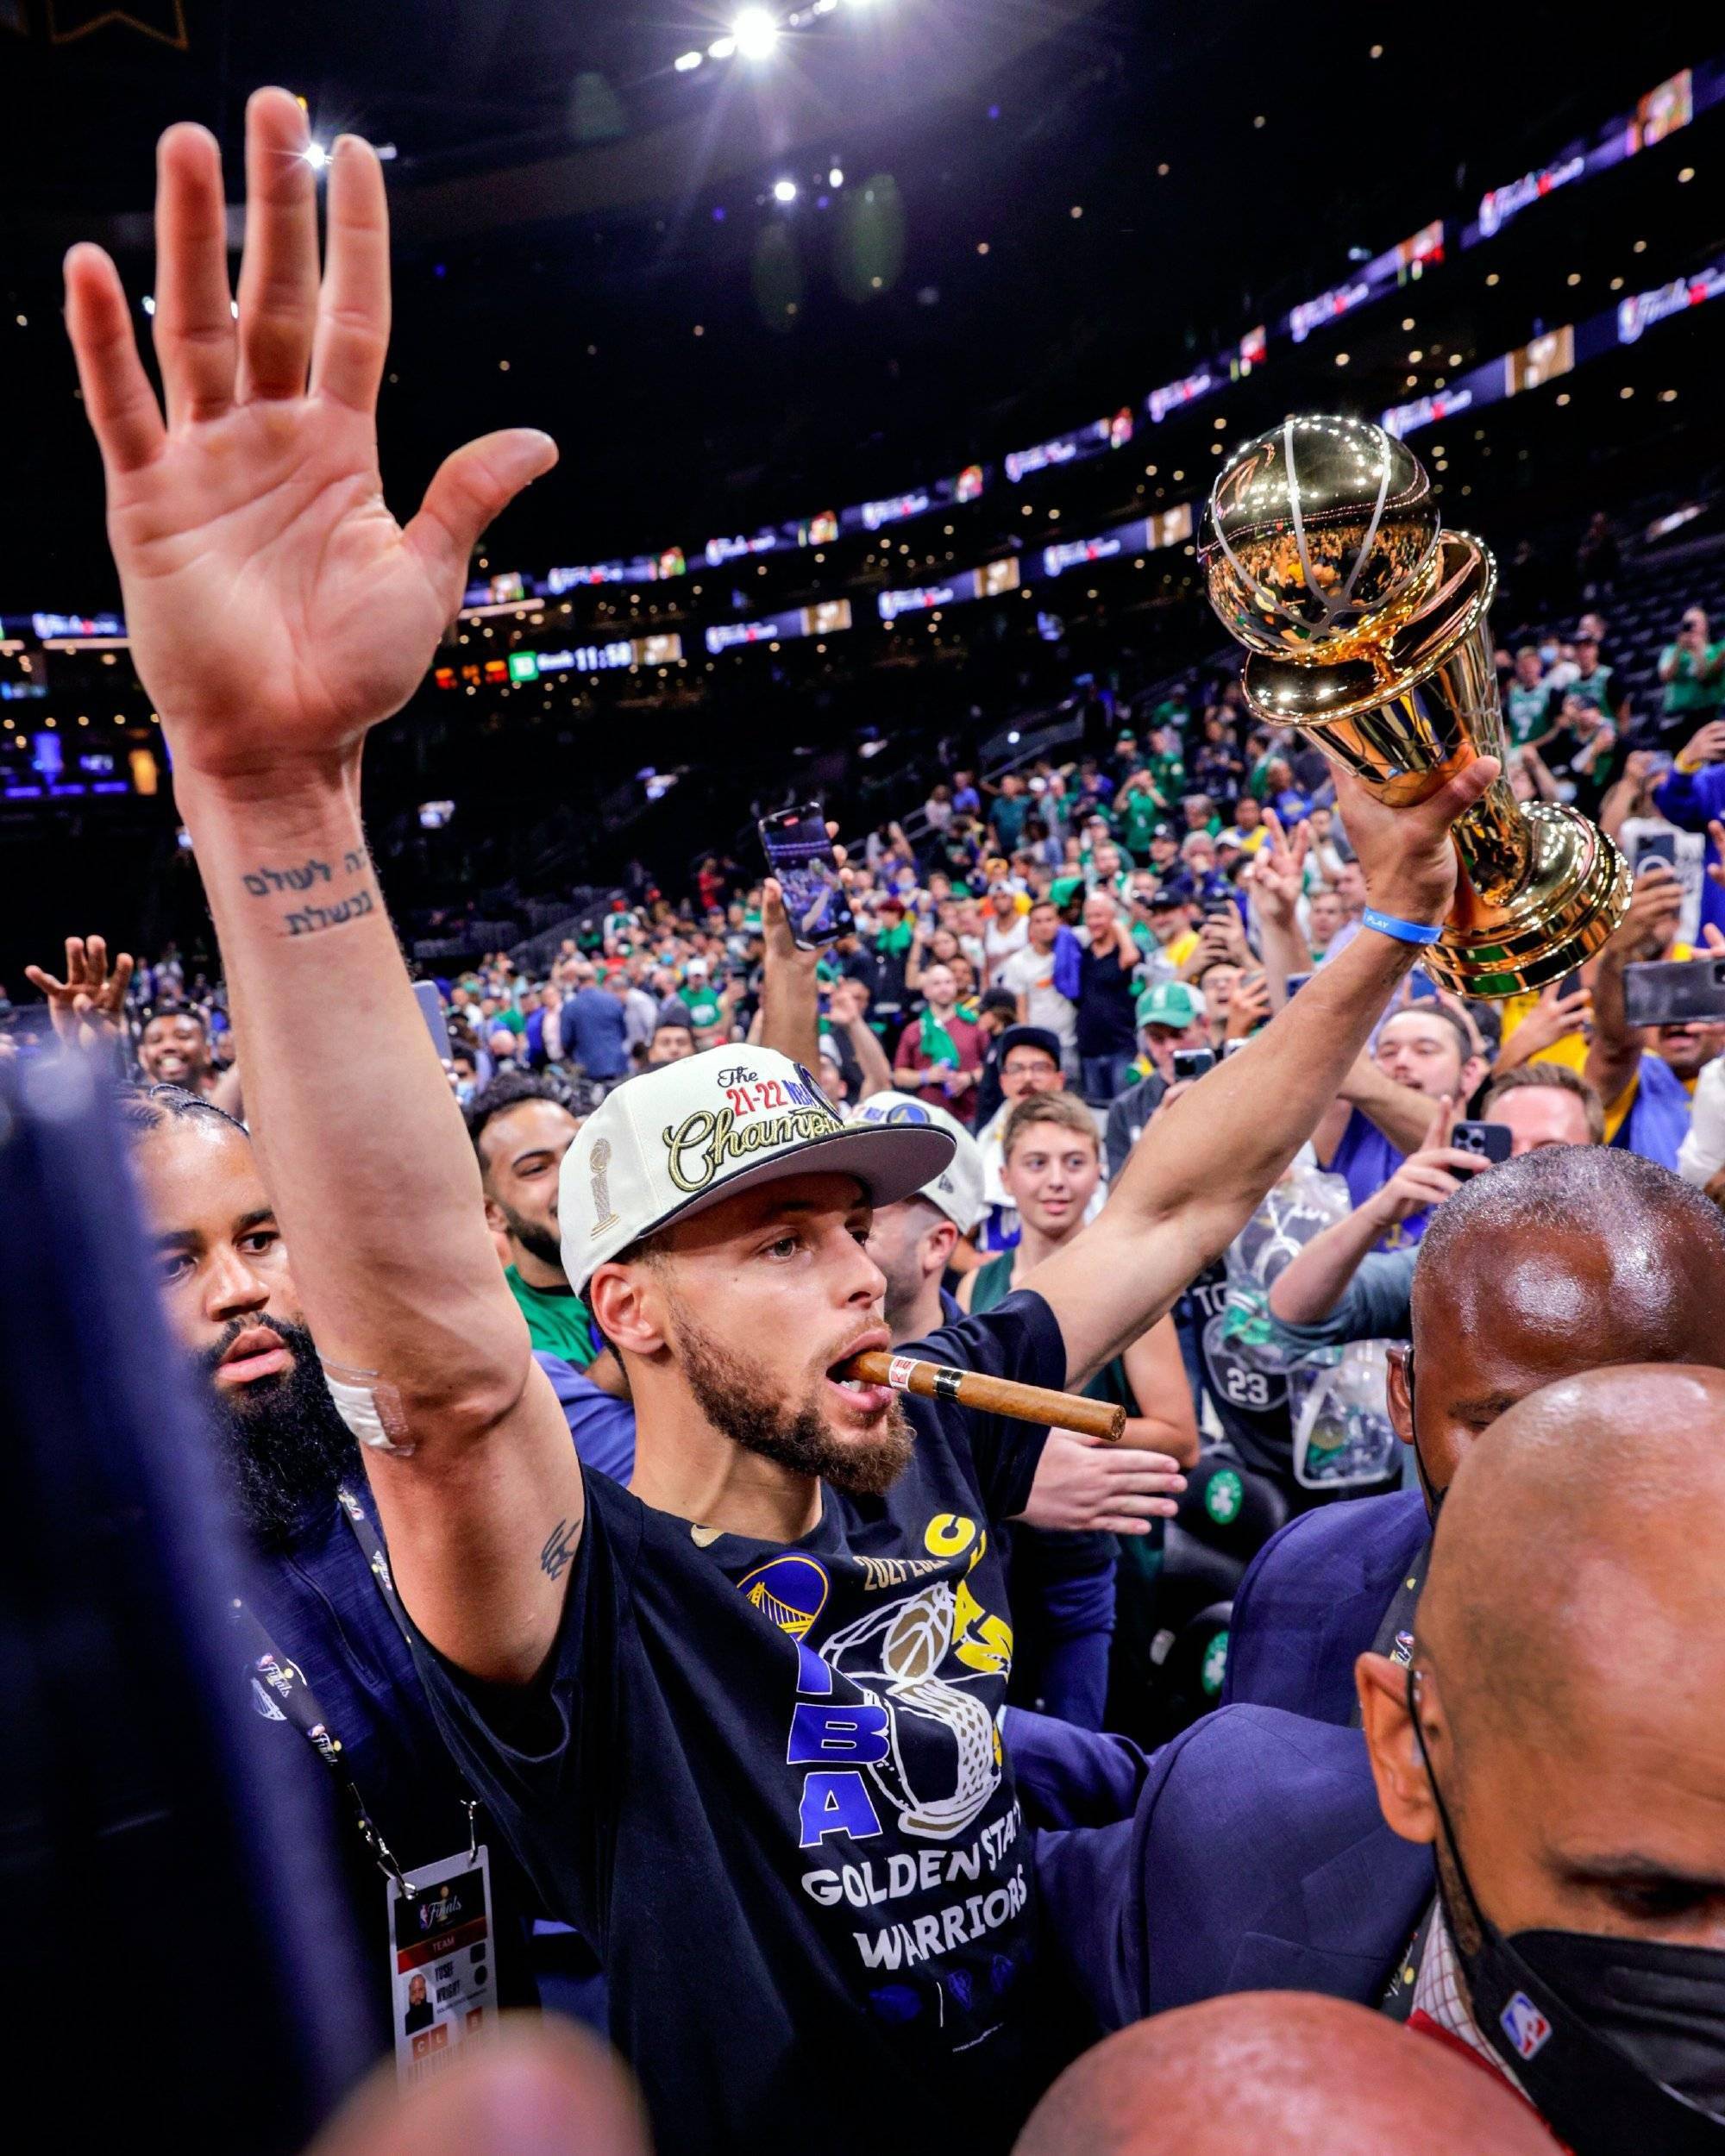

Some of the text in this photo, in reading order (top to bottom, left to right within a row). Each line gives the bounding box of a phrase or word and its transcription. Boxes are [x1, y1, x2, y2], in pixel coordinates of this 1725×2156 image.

[717, 1066, 758, 1087] The
[725, 1080, 788, 1117] 21-22
[1226, 1367, 1269, 1404] 23
[801, 1843, 981, 1908] GOLDEN
[853, 1864, 1027, 1970] WARRIORS
[433, 1936, 455, 1952] TEAM
